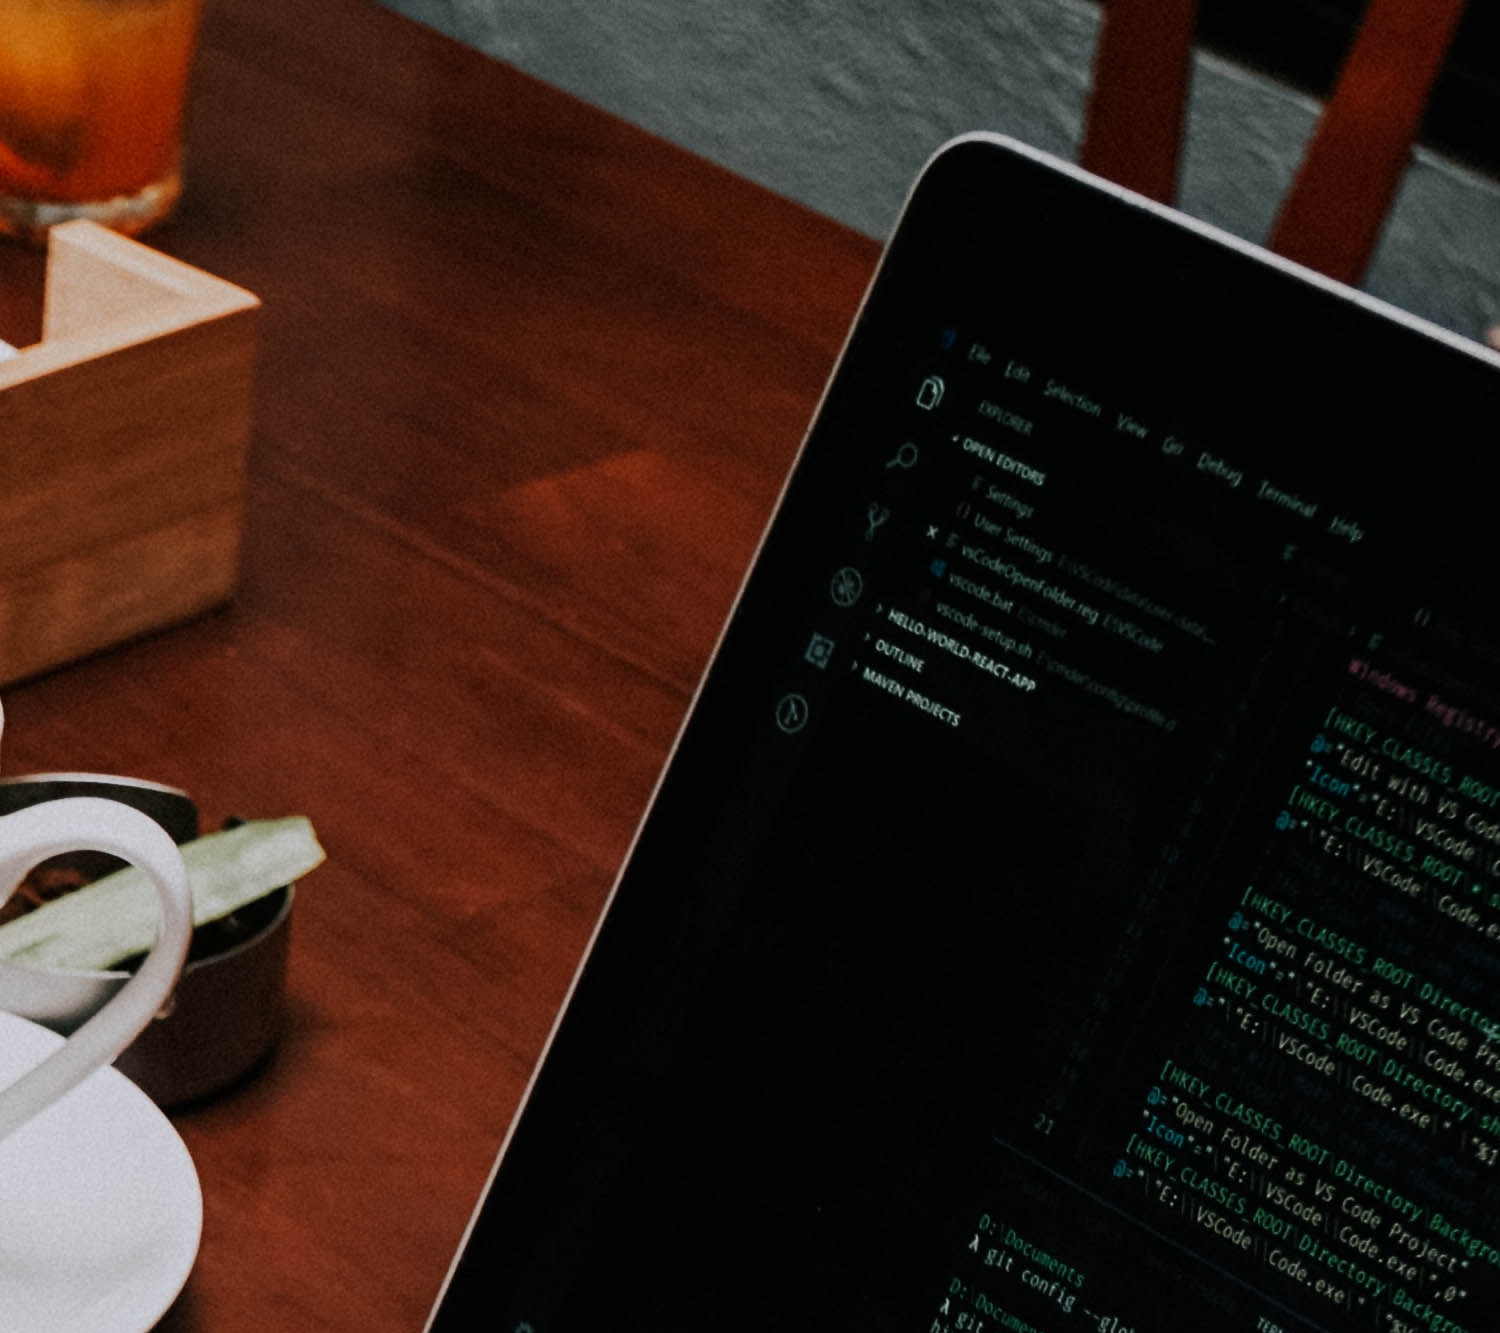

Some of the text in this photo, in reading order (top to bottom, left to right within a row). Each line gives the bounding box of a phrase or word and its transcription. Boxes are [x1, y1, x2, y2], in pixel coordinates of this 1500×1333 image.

[967, 342, 1363, 543] File Edit Selection View Go Debug Terminal Help
[977, 399, 1033, 434] EXPLORER
[961, 436, 1045, 486] OPEN EDITORS
[985, 484, 1034, 519] Settings
[972, 512, 1053, 563] User Settings
[948, 573, 1014, 613] vscode.bat
[874, 638, 924, 673] OUTLINE
[888, 609, 1036, 690] HELLO-WORLD-REACT-APP
[935, 602, 1032, 658] vscode-setup.sh
[862, 666, 960, 727] MAVEN PROJECTS
[1386, 776, 1429, 804] with
[1436, 797, 1458, 820] VS
[1303, 951, 1363, 993] Folder
[1368, 989, 1390, 1010] as
[1398, 1001, 1420, 1025] VS
[1426, 1017, 1468, 1051] Code
[1220, 1126, 1278, 1169] Folder
[1283, 1166, 1305, 1187] as
[1313, 1178, 1336, 1203] VS
[1340, 1195, 1382, 1229] Code
[1387, 1221, 1469, 1272] Project"
[983, 1247, 1014, 1272] git
[1020, 1268, 1076, 1313] config
